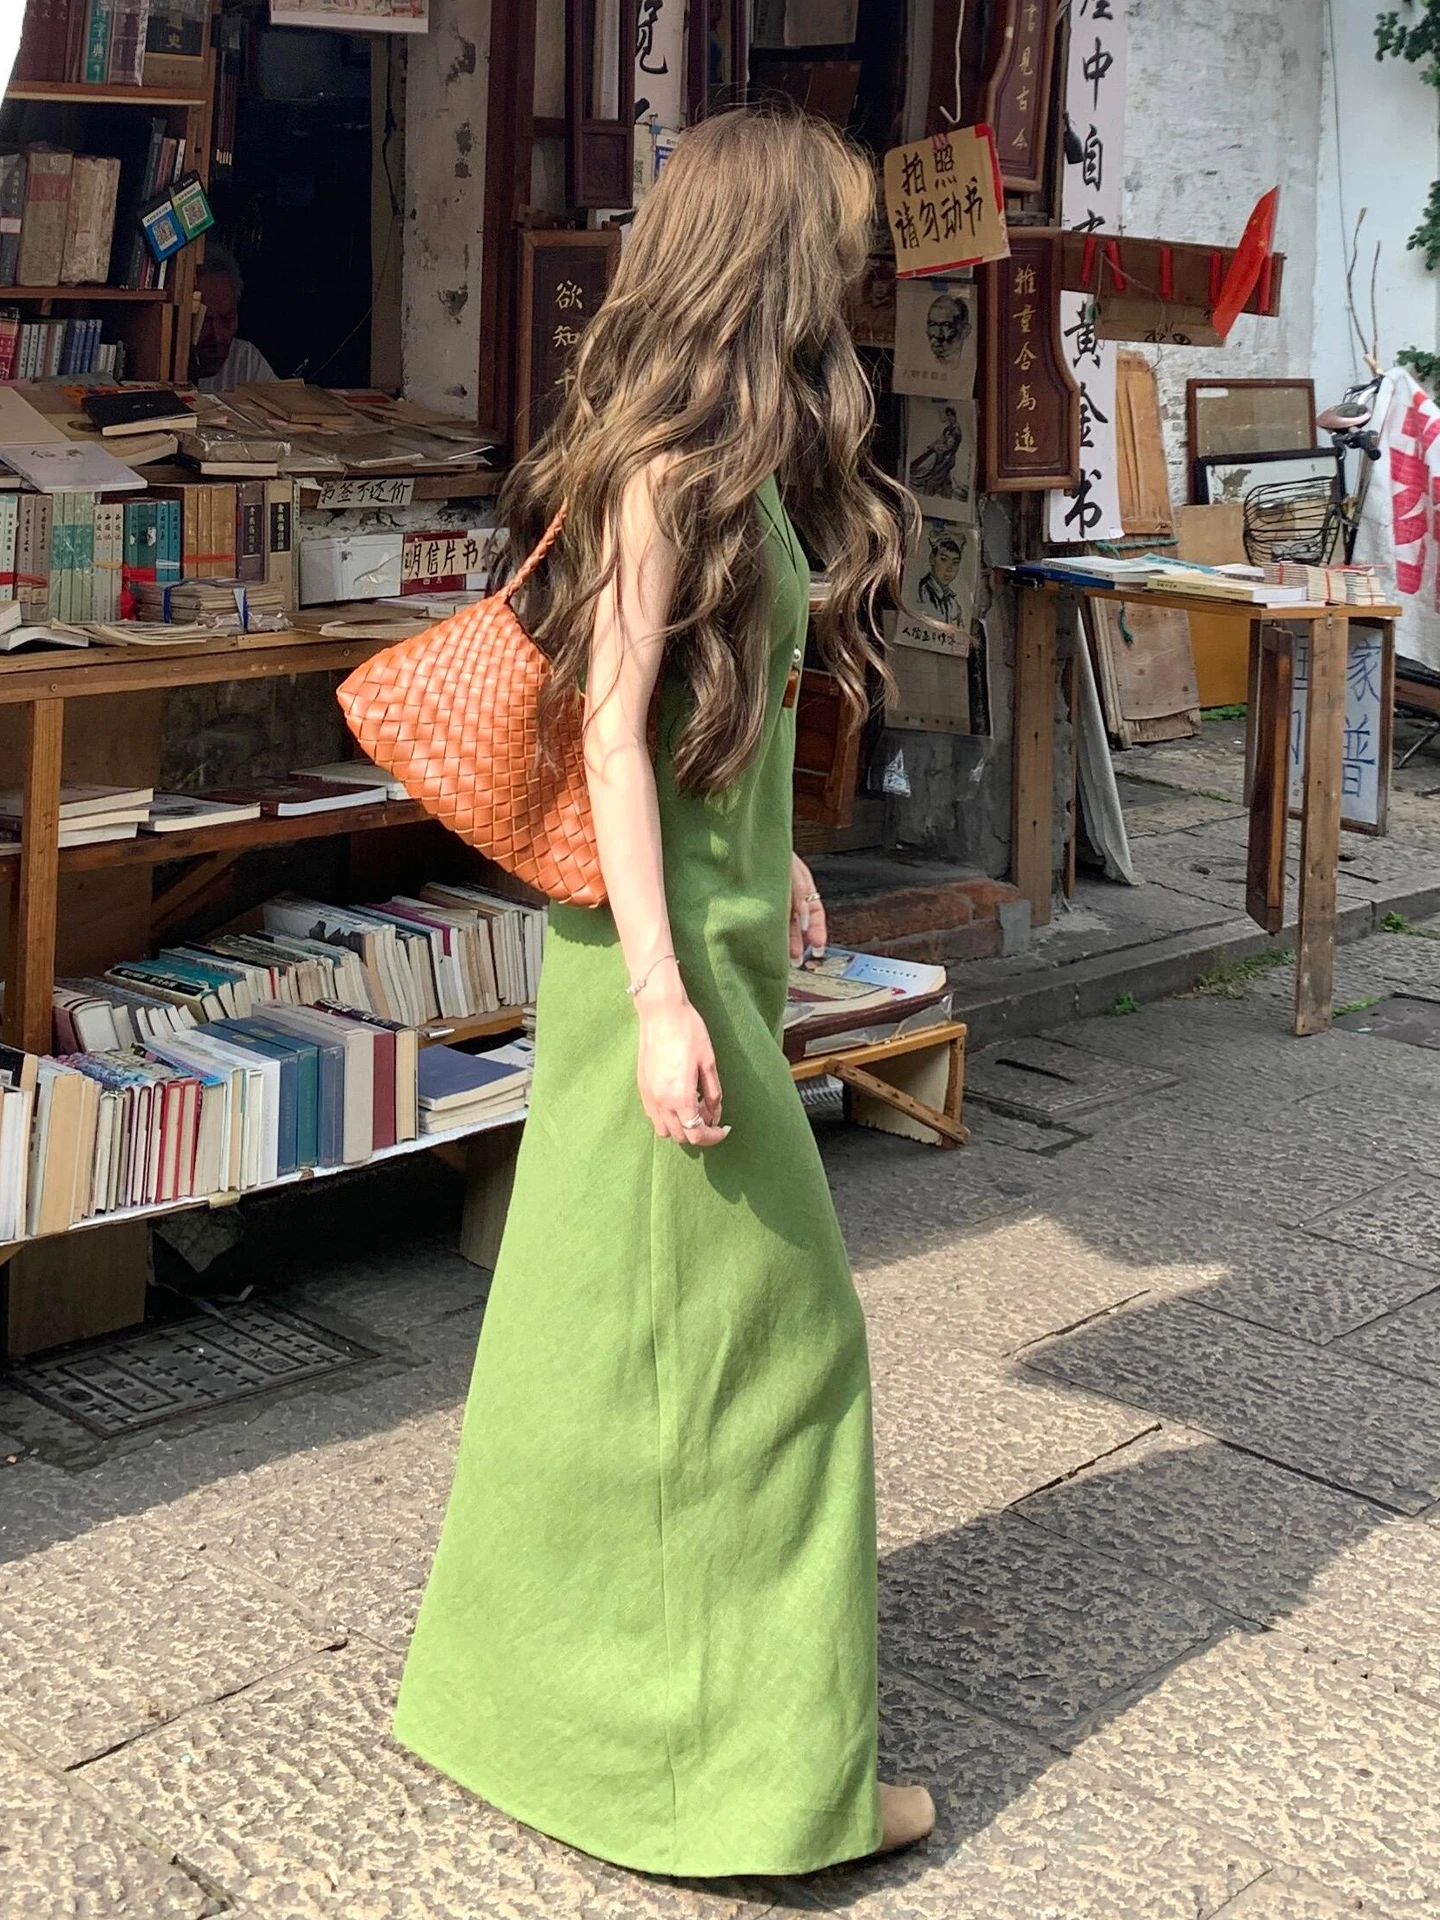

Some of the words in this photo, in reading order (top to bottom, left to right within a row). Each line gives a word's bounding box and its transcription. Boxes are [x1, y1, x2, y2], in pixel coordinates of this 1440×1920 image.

[902, 144, 957, 196] 拍照
[894, 176, 983, 249] 请勿动书
[553, 280, 583, 398] 欲知千
[321, 480, 411, 503] 书签不还价
